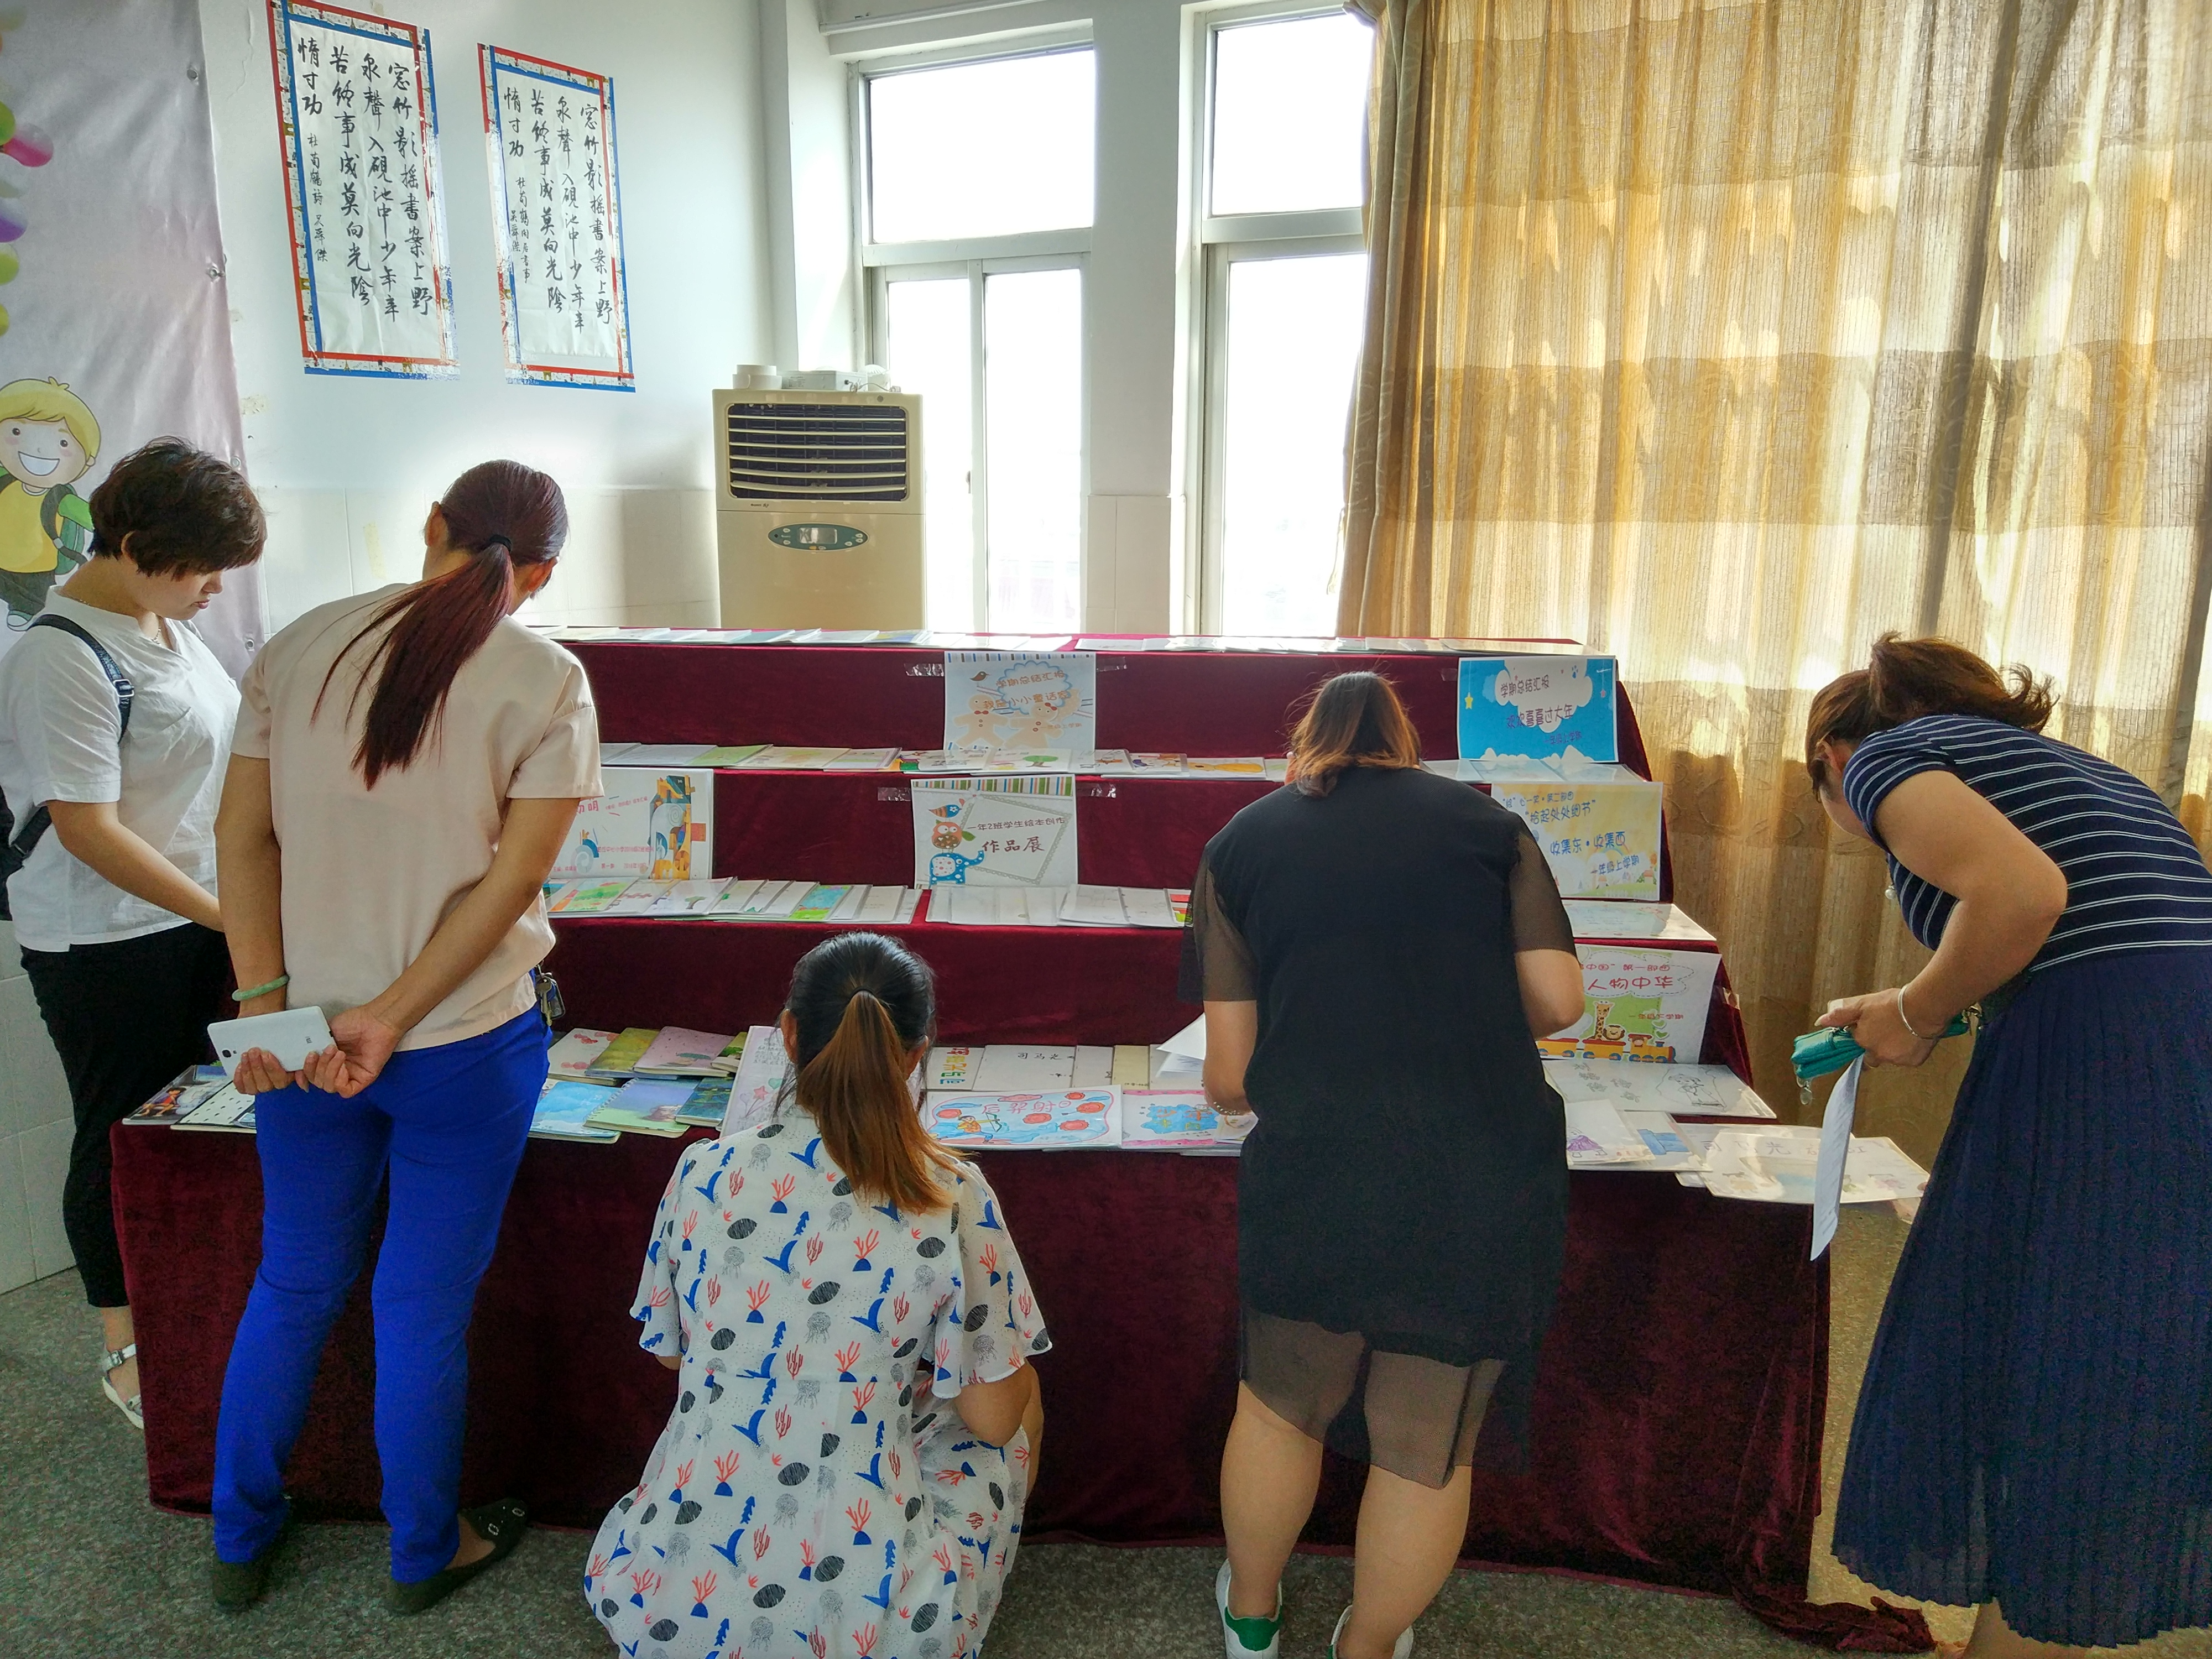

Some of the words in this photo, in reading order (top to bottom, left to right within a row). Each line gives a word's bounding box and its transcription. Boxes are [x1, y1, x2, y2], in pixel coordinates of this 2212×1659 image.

[996, 670, 1065, 688] 学期总结汇报
[1500, 675, 1550, 698] 学期总结汇报
[1506, 703, 1573, 729] 欢欢喜喜过大年
[966, 817, 1065, 831] 一年2班学生绘本创作
[982, 836, 1045, 853] 作品展
[1590, 854, 1640, 875] 一年级上学期
